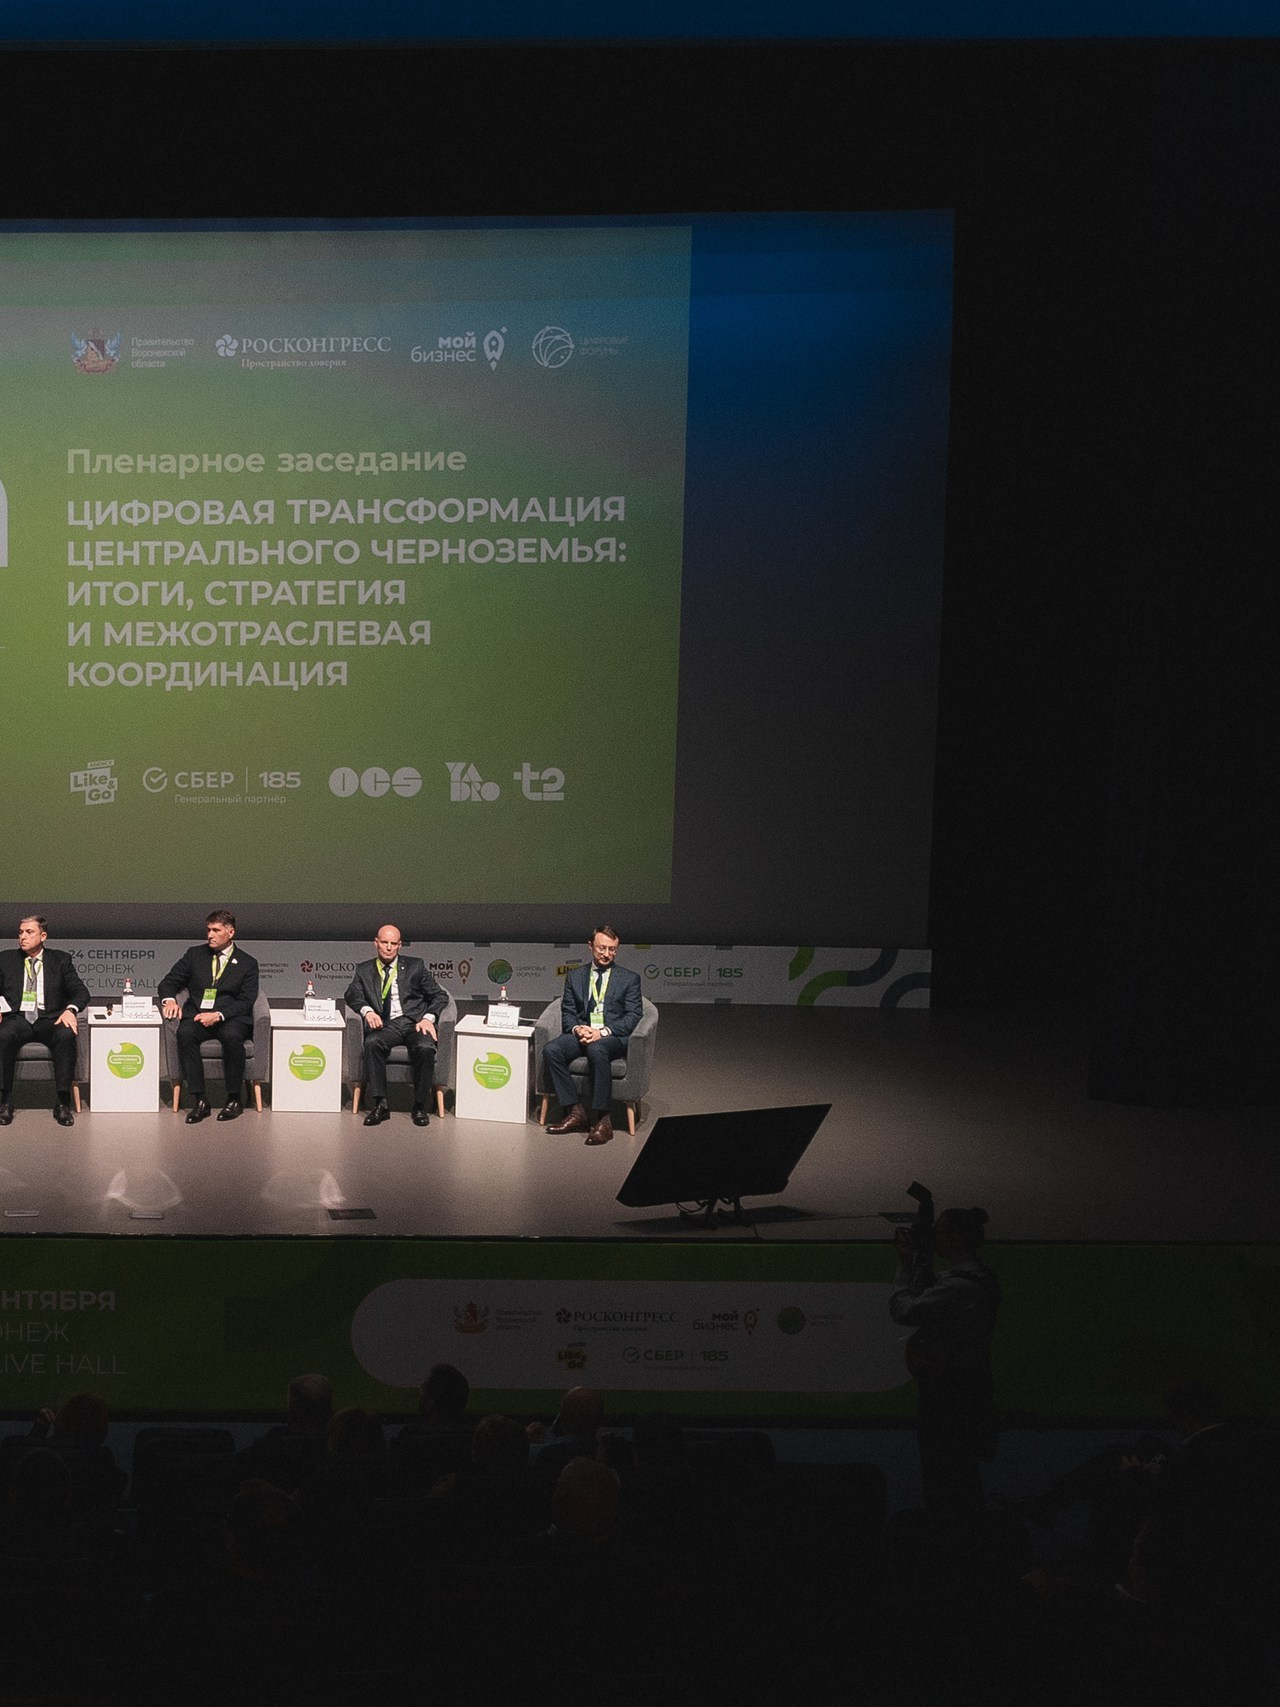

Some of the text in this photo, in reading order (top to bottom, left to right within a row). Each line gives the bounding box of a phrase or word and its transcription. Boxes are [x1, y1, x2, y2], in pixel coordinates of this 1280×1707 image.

[241, 336, 392, 354] РОСКОНГРЕСС
[438, 332, 476, 349] мой
[411, 346, 477, 363] бизнес
[241, 358, 307, 369] Пространство
[67, 448, 468, 479] Пленарное заседание
[67, 495, 627, 530] ЦИФРОВАЯ ТРАНСФОРМАЦИЯ
[67, 537, 628, 571] ЦЕНТРАЛЬНОГО ЧЕРНОЗЕМЬЯ:
[67, 579, 406, 611] ИТОГИ, СТРАТЕГИЯ
[67, 619, 432, 647] И МЕЖОТРАСЛЕВАЯ
[67, 661, 349, 691] КООРДИНАЦИЯ
[73, 772, 109, 788] Like
[174, 771, 302, 789] СБЕР 185
[513, 762, 566, 801] t2
[88, 788, 112, 802] Go
[174, 794, 242, 804] Генеральный
[87, 949, 156, 960] СЕНТЯБРЯ
[663, 966, 744, 978] СБЕР 185
[574, 1311, 679, 1323] РОСКОНГРЕСС
[644, 1350, 728, 1362] СБЕР 185
[55, 1354, 127, 1376] HALL
